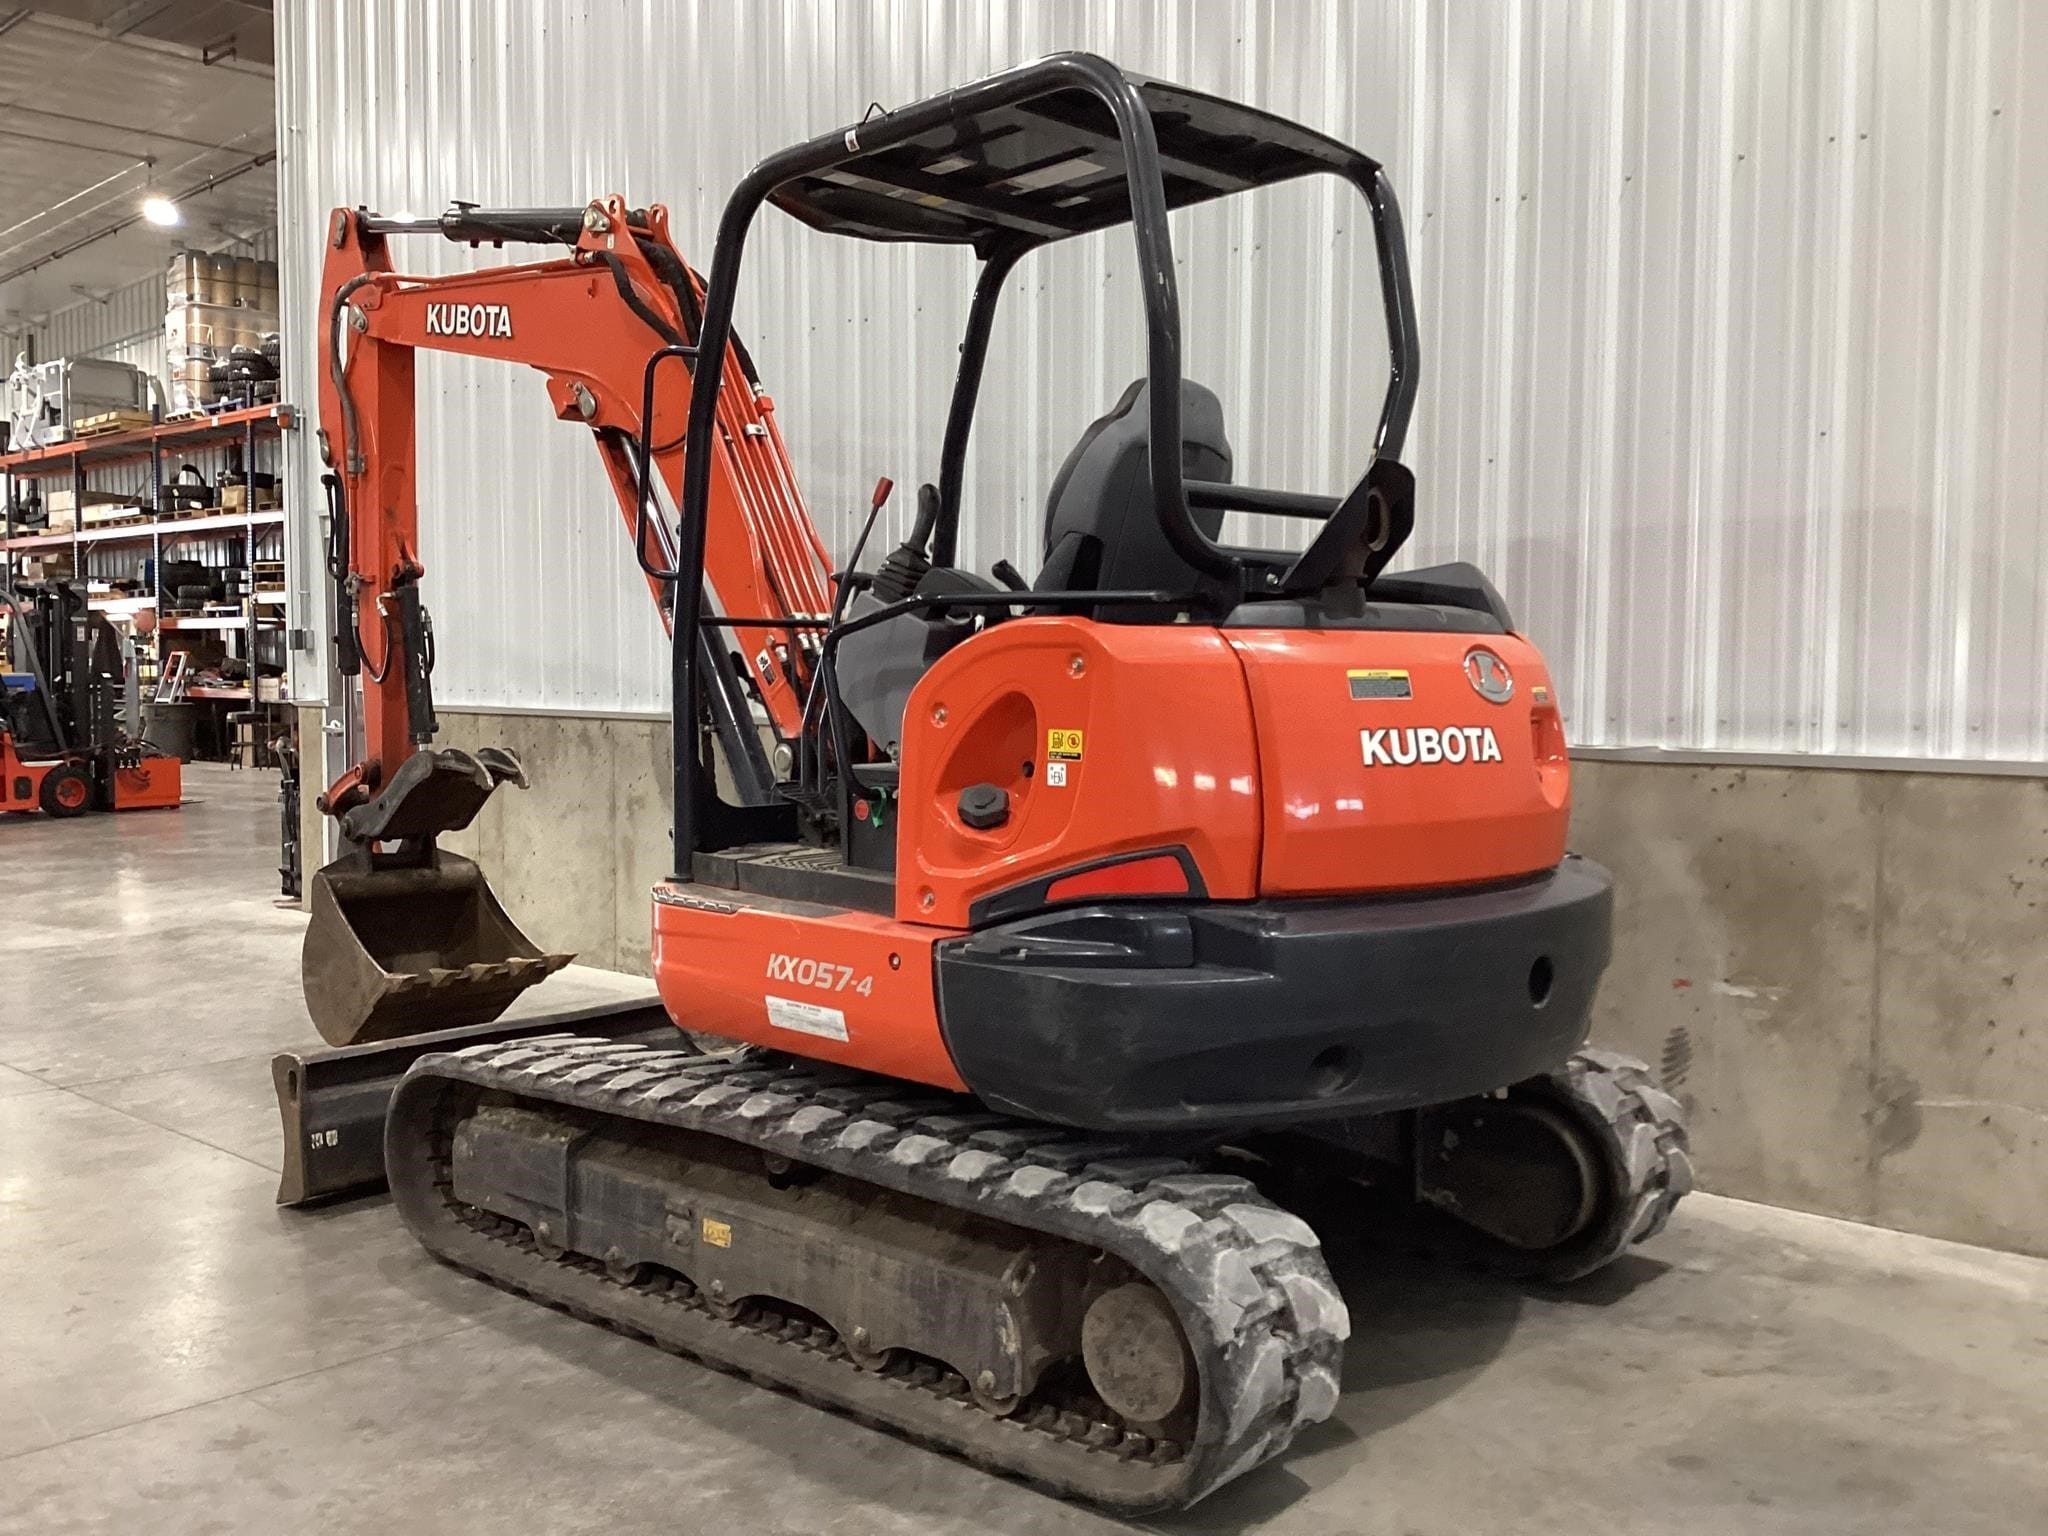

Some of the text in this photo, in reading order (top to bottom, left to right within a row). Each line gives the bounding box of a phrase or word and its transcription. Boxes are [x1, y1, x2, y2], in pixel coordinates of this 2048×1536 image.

[426, 303, 512, 337] KUBOTA
[1360, 726, 1502, 766] KUBOTA
[766, 953, 873, 997] KX057-4
